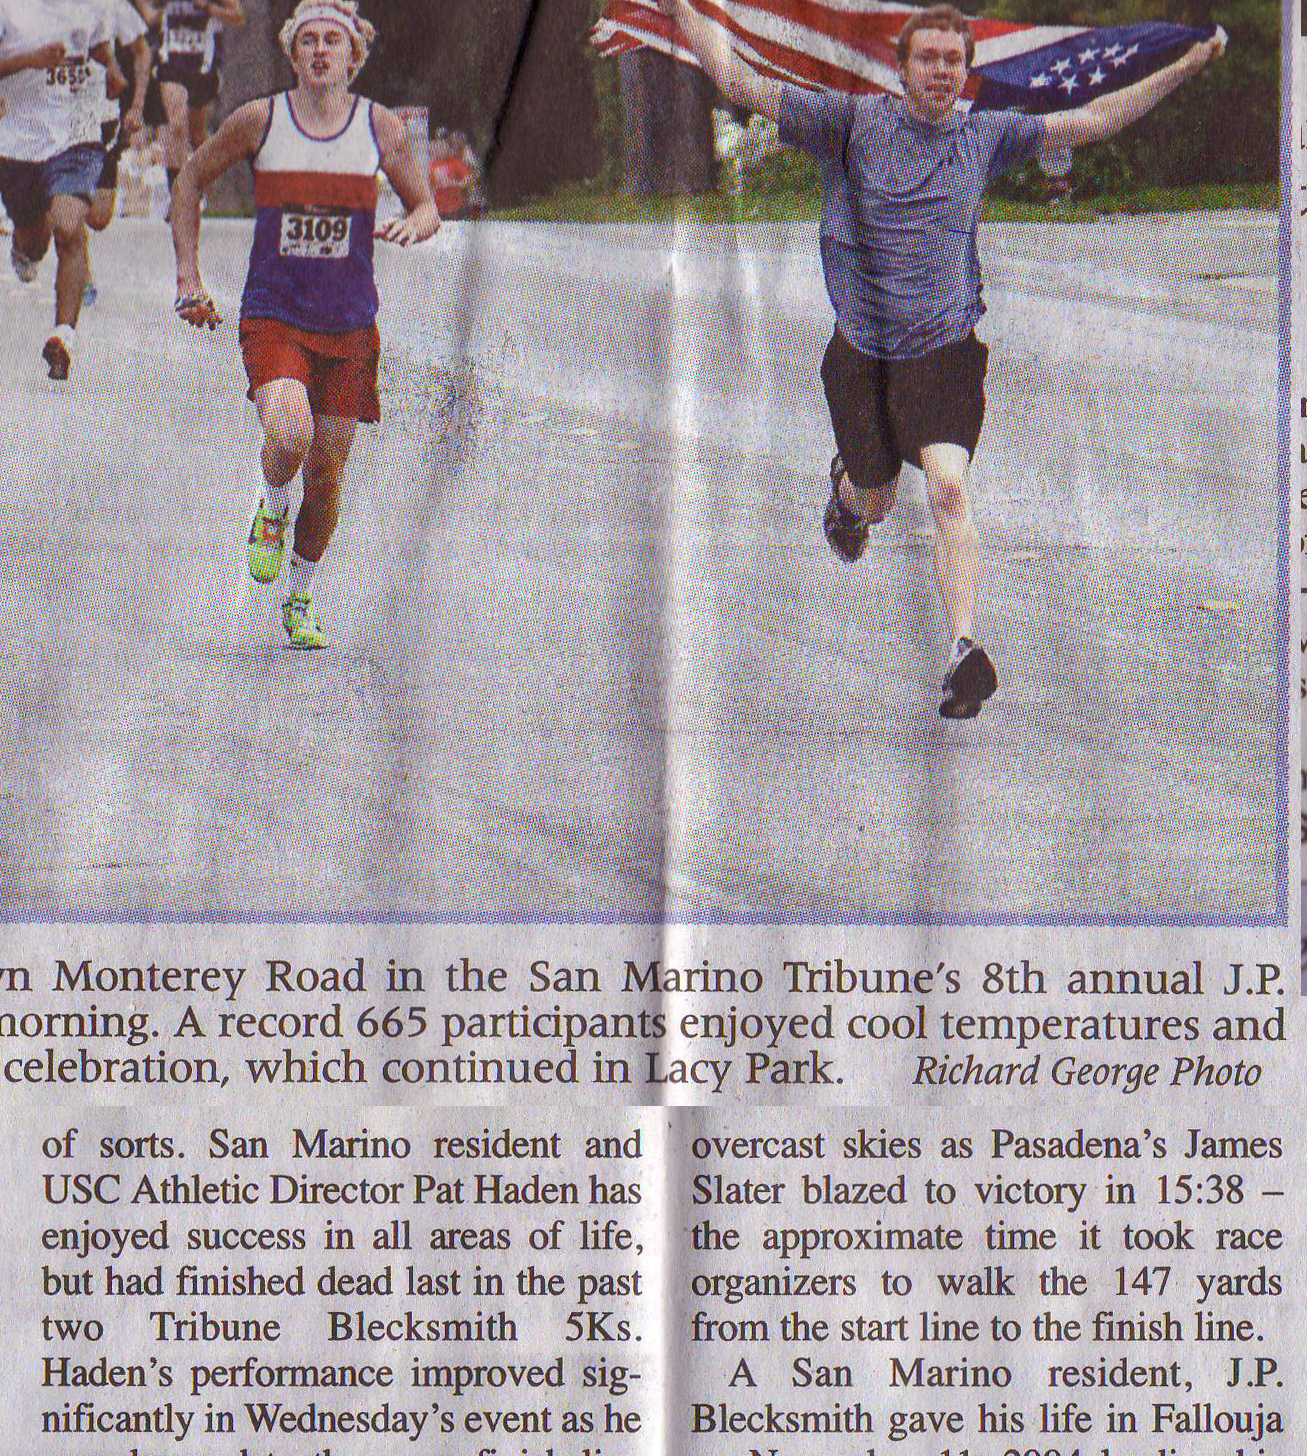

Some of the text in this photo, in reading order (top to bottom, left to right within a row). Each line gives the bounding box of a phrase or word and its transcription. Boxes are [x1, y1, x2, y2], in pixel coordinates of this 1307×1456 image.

[286, 216, 348, 242] 3109
[51, 959, 247, 1002] Monterey
[265, 957, 367, 993] Road
[386, 958, 426, 993] in
[445, 957, 508, 993] the
[529, 959, 602, 993] San
[622, 959, 765, 994] Marino
[782, 958, 961, 995] Tribune's
[982, 959, 1048, 995] 8th
[1067, 960, 1205, 996] annual
[1223, 963, 1285, 996] J.P.
[912, 1053, 1263, 1095] Richard George Photo
[42, 1173, 643, 1205] USC Athletic Director Pat Haden has
